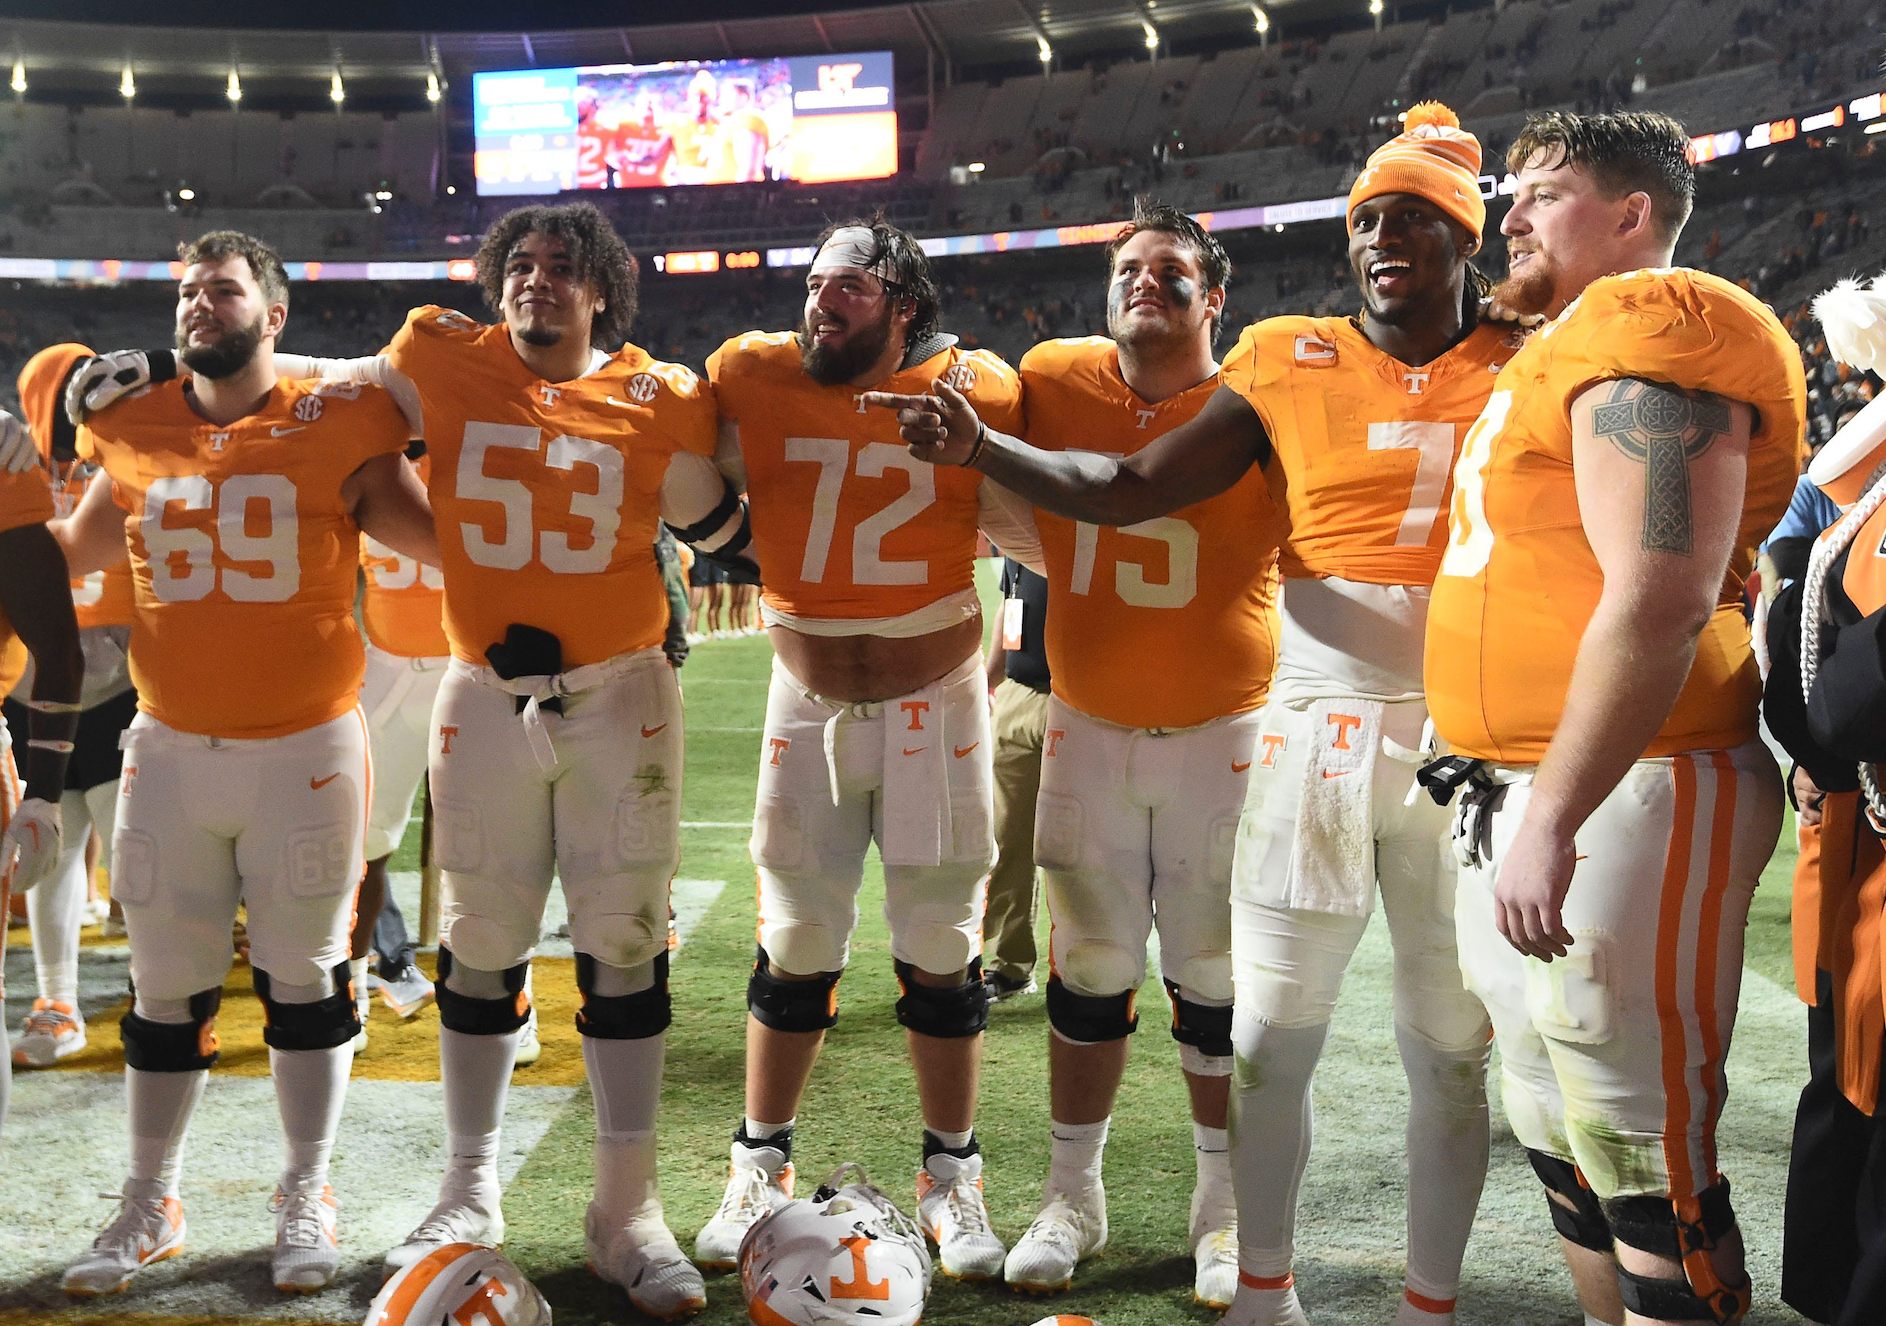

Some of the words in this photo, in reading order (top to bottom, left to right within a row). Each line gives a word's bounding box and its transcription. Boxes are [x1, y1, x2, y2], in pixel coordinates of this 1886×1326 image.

[1359, 167, 1379, 189] T
[629, 374, 659, 402] SEC
[947, 365, 977, 390] SEC
[1403, 373, 1428, 394] T
[295, 395, 323, 422] SEC
[540, 387, 561, 406] T
[1136, 409, 1155, 429] T
[210, 433, 229, 451] T
[456, 421, 625, 573] 53
[1368, 421, 1455, 547] 7
[785, 437, 936, 586] 72
[141, 474, 300, 602] 69
[901, 702, 930, 730] T
[440, 724, 459, 754] T
[1047, 730, 1064, 757] T
[1327, 713, 1362, 749] T
[769, 737, 790, 766] T
[1262, 735, 1284, 766] T
[123, 765, 138, 796] T
[830, 1237, 890, 1300] T
